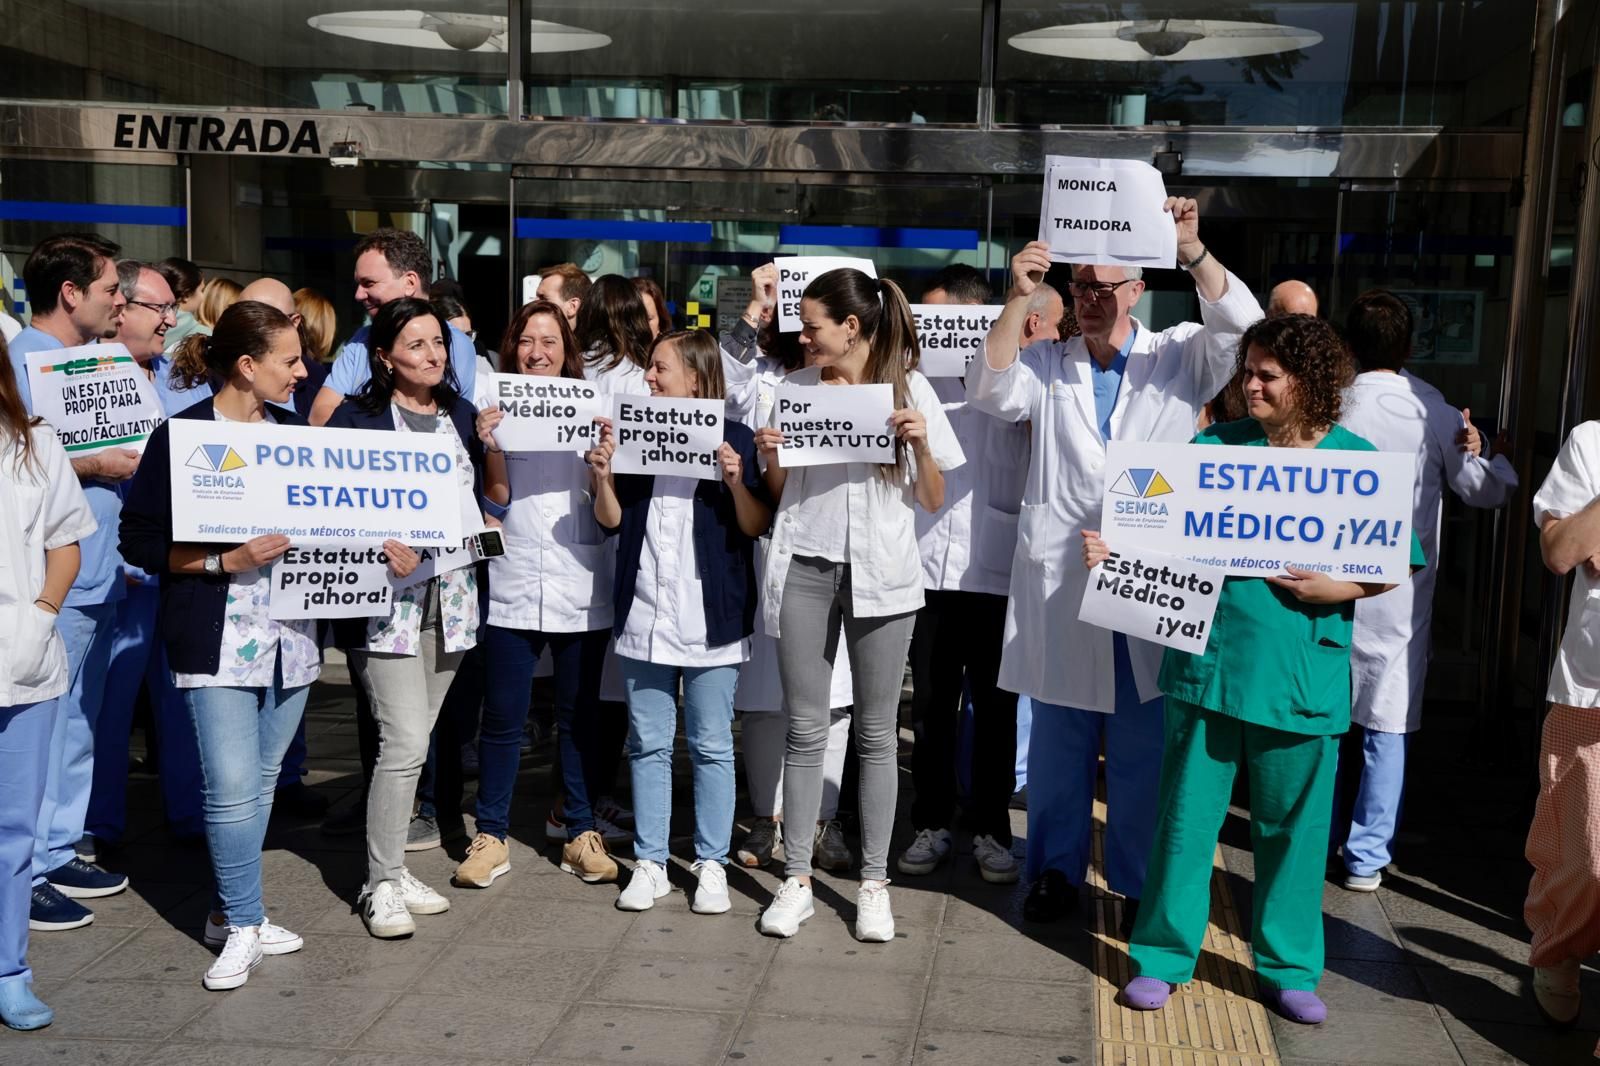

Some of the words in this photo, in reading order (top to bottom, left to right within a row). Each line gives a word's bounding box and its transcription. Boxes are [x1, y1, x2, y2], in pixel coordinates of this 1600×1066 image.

[114, 114, 322, 154] ENTRADA
[1058, 179, 1117, 192] MONICA
[1054, 217, 1132, 232] TRAIDORA
[780, 269, 809, 282] Por
[62, 385, 77, 400] UN
[79, 378, 137, 398] ESTATUTO
[498, 381, 595, 400] Estatuto
[65, 396, 107, 416] PROPIO
[111, 391, 142, 409] PARA
[499, 400, 576, 418] Médico
[780, 399, 811, 414] Por
[95, 411, 110, 425] EL
[620, 403, 717, 427] Estatuto
[780, 418, 853, 432] nuestro
[57, 417, 164, 445] ÉDICO/FACULTATIVO
[557, 420, 596, 443] ¡ya!
[619, 426, 689, 448] propio
[782, 434, 890, 449] ESTATUTO
[256, 444, 315, 468] POR
[324, 447, 451, 474] NUESTRO
[642, 445, 717, 466] ¡ahora!
[192, 475, 245, 489] SEMCA
[1199, 462, 1379, 496] ESTATUTO
[287, 484, 428, 510] ESTATUTO
[1114, 500, 1169, 516] SEMCA
[198, 524, 248, 535] Sindicato
[310, 526, 356, 537] MÉDICOS
[358, 528, 402, 539] Canarias
[410, 530, 445, 540] SEMCA
[1184, 505, 1324, 543] MÉDICO
[1333, 518, 1402, 550] ¡YA!
[283, 546, 392, 565] Estatuto
[1230, 557, 1280, 570] MÉDICOS
[1283, 560, 1333, 573] Canarias
[1342, 564, 1383, 575] SEMCA
[281, 567, 359, 590] propio
[1102, 552, 1214, 595] Estatuto
[304, 586, 387, 610] ¡ahora!
[1096, 573, 1185, 611] Médico
